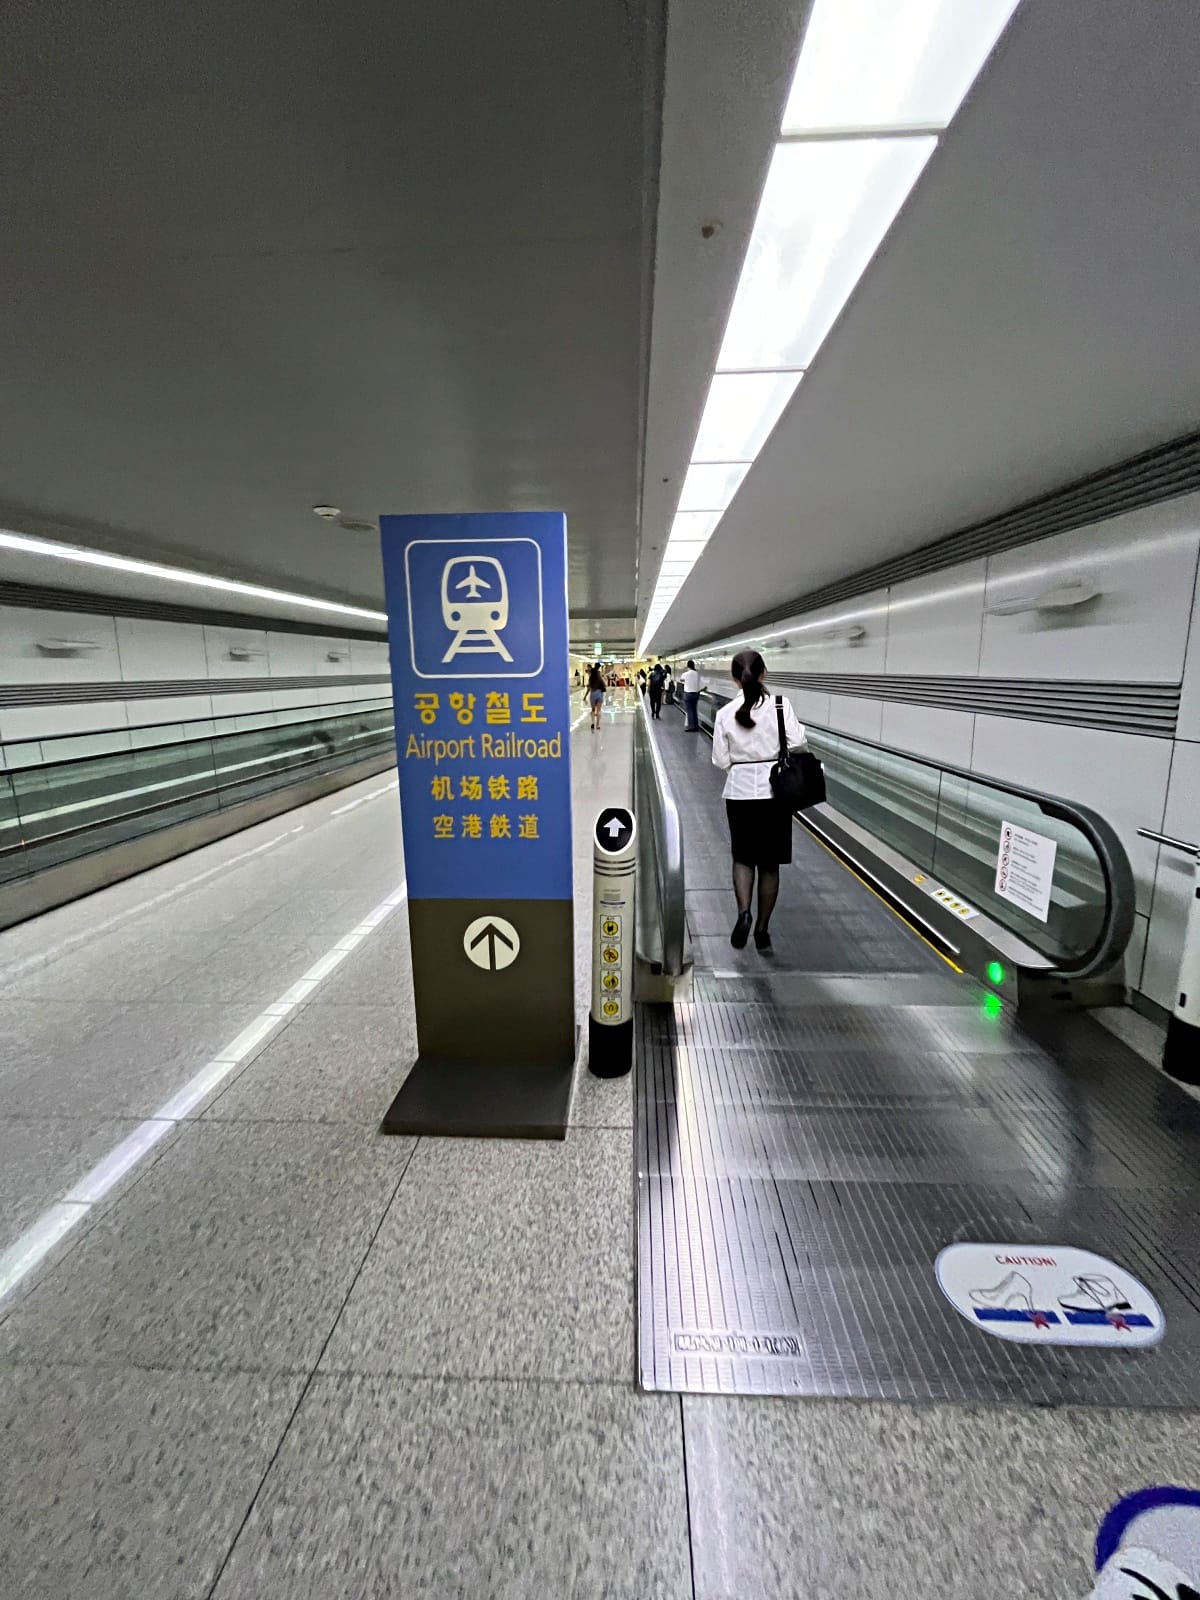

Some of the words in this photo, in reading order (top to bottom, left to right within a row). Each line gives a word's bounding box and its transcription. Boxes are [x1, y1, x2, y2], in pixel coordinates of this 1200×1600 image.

[414, 691, 547, 725] 공항철도
[405, 732, 476, 766] Airport
[481, 731, 561, 759] Railroad
[431, 774, 539, 800] 机场铁路
[994, 1255, 1057, 1266] CAUTION!
